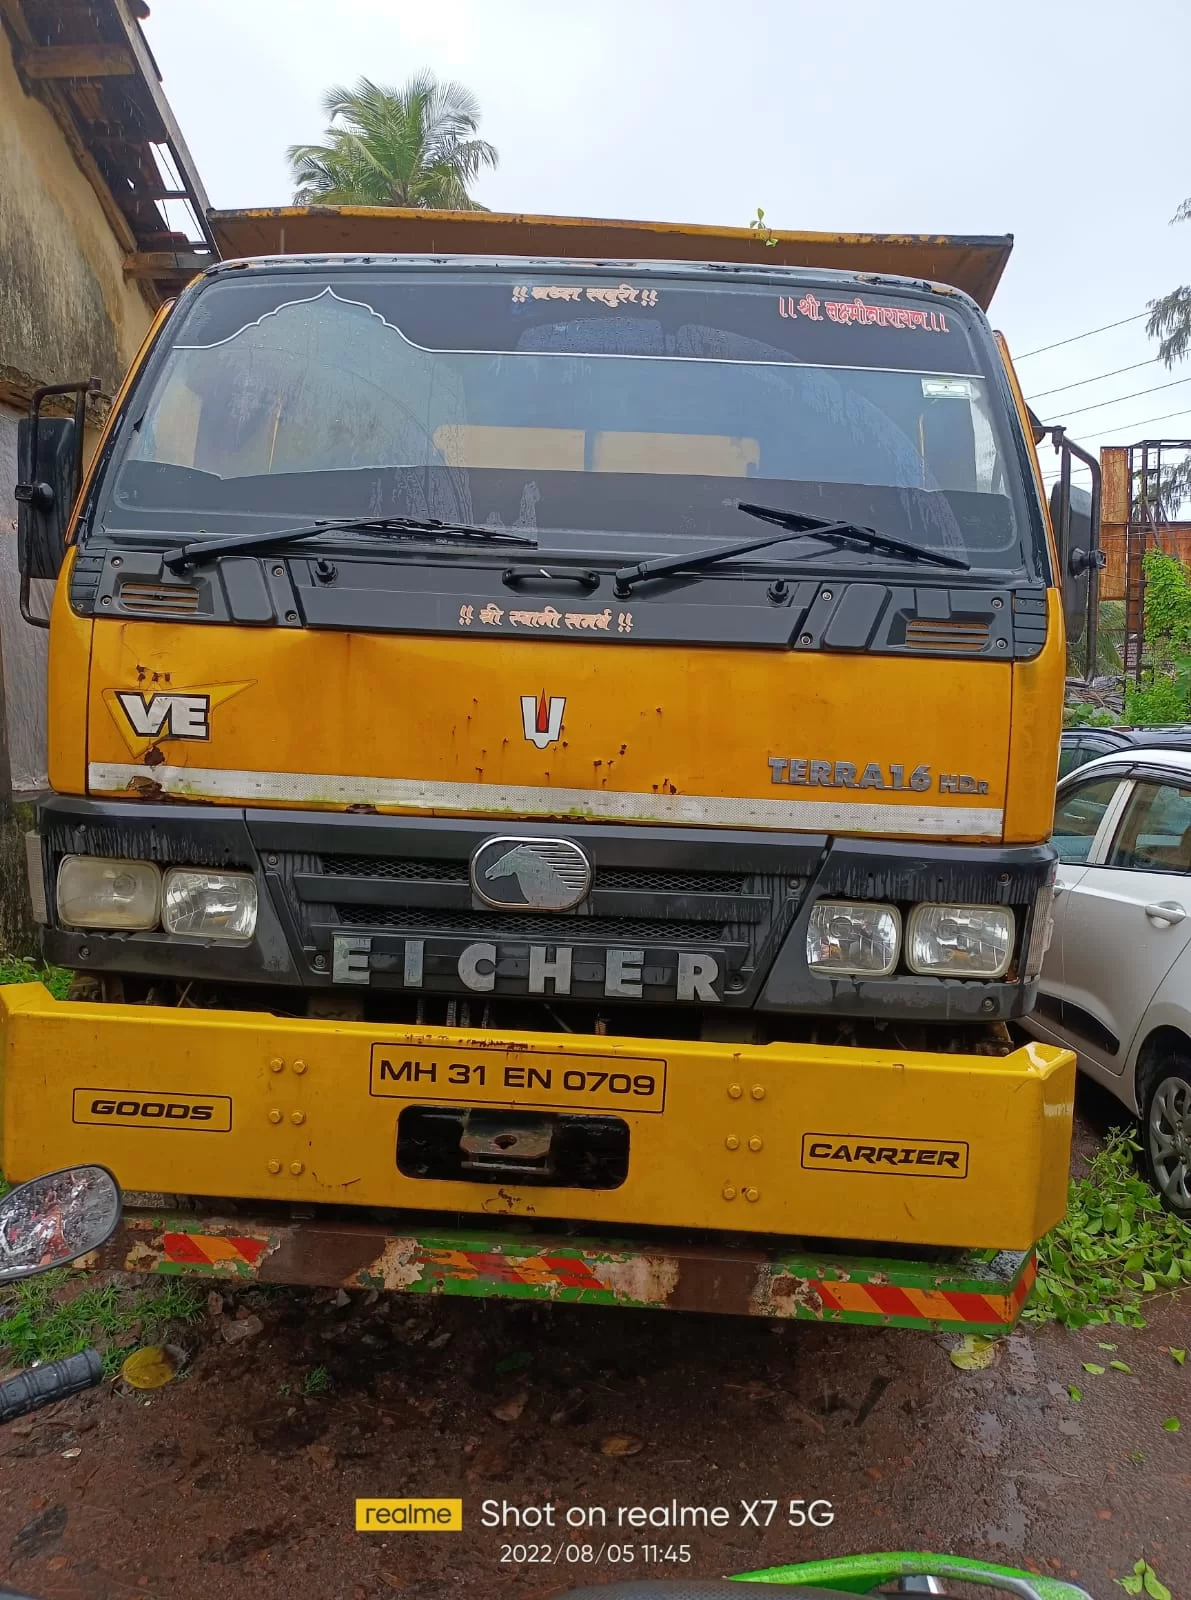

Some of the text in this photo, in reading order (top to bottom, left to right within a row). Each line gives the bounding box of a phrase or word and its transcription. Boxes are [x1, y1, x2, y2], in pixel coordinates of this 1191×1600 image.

[508, 605, 562, 629] स्वामी
[564, 608, 612, 631] समर्थ
[114, 691, 211, 740] VE
[332, 933, 721, 1002] EICHER
[380, 1060, 655, 1096] MH 31 EN 0709
[91, 1099, 214, 1121] GOODS
[809, 1143, 960, 1169] CARRIER
